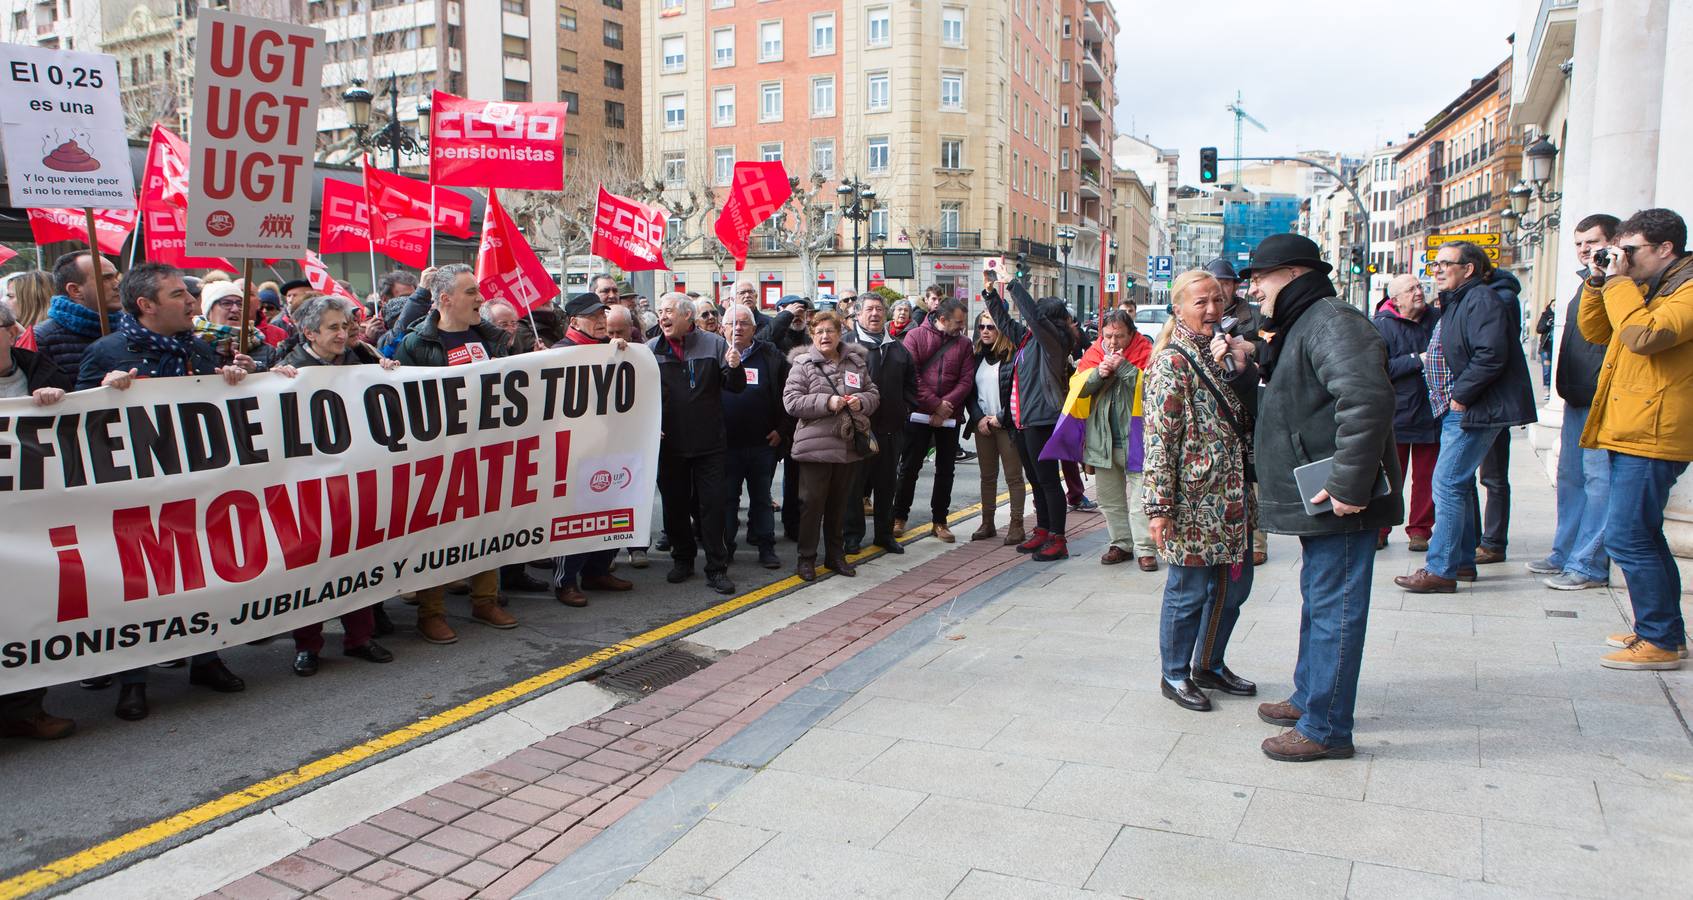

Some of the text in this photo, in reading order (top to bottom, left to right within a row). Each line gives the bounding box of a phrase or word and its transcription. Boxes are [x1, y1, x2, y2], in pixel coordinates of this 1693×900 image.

[210, 21, 314, 87] UGT
[10, 61, 103, 89] El 0,25
[30, 99, 94, 115] es una
[206, 85, 309, 146] UGT
[434, 145, 555, 162] pensionistas
[22, 186, 123, 198] si no lo remediamos
[23, 173, 119, 187] Y lo que viene peor
[203, 148, 303, 203] UGT
[280, 389, 352, 458] LO
[363, 376, 468, 452] QUE
[478, 370, 529, 430] ES
[541, 361, 636, 421] TUYO
[113, 435, 539, 602] MOVILIZATE
[554, 515, 609, 536] CCOO
[1, 527, 544, 668] SIONISTAS, JUBILADAS Y JUBILIADOS
